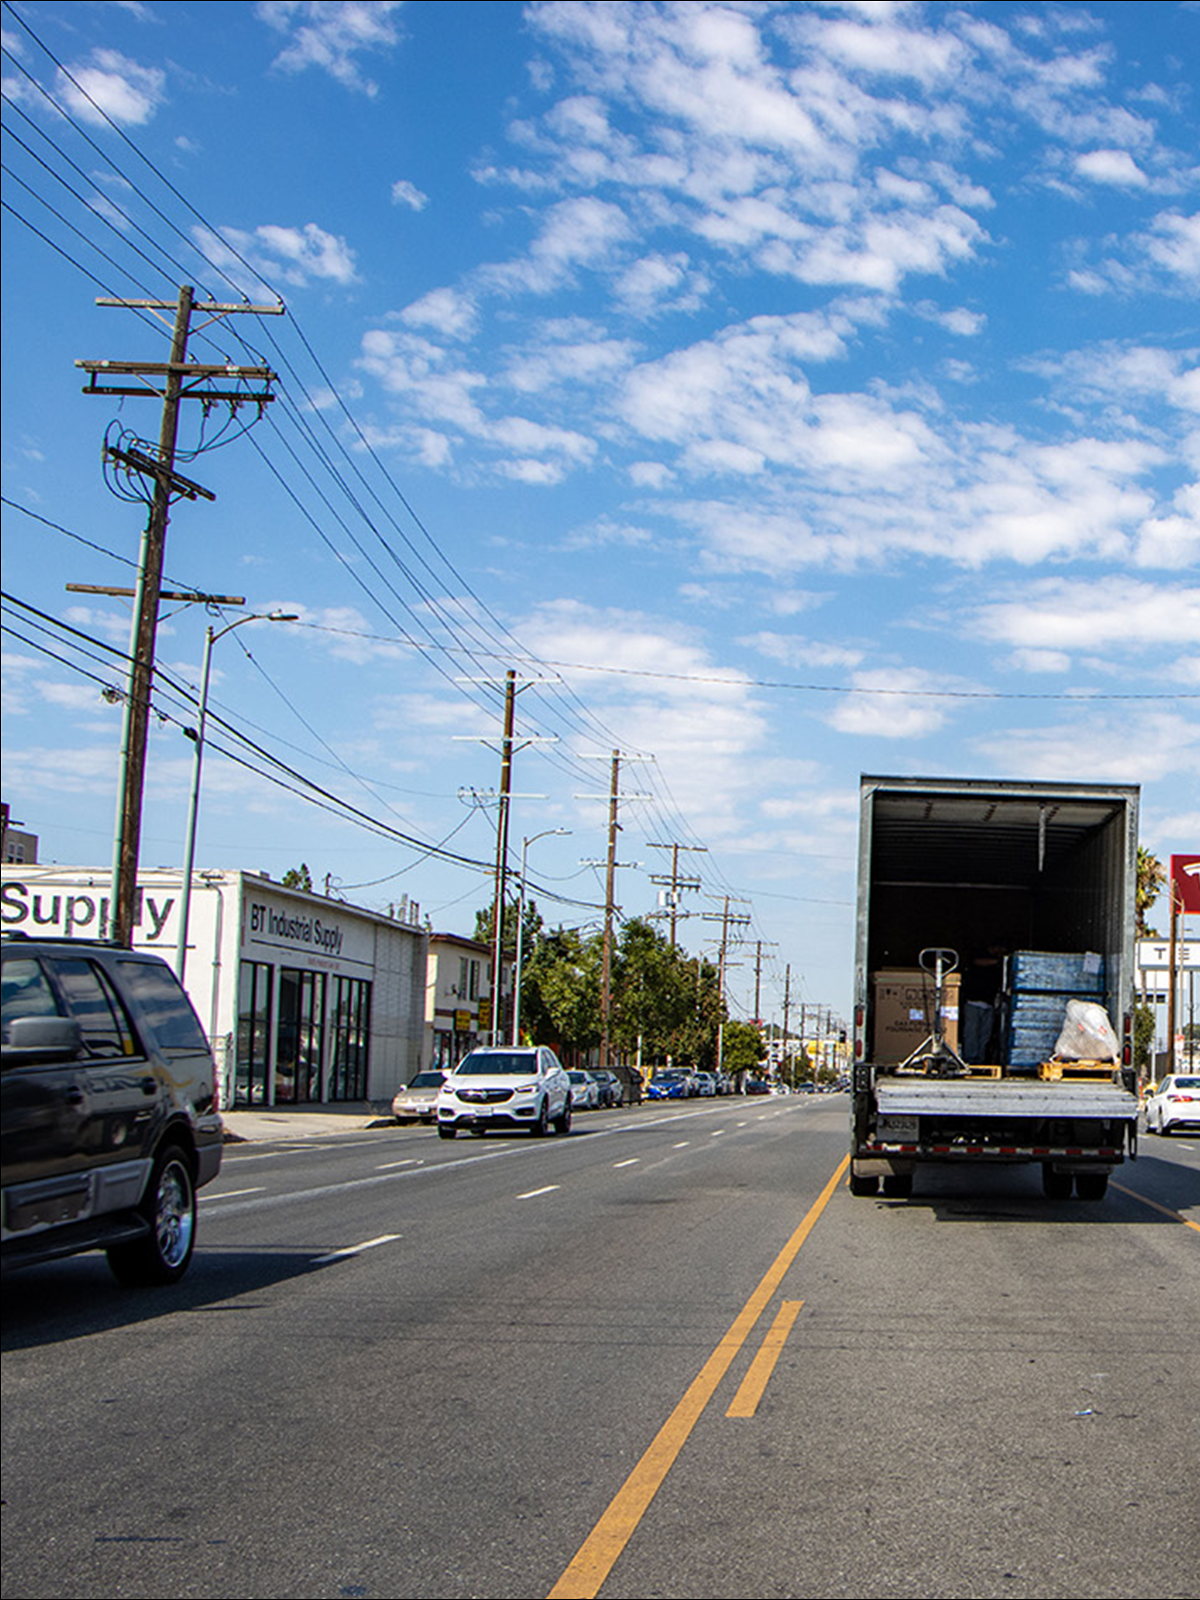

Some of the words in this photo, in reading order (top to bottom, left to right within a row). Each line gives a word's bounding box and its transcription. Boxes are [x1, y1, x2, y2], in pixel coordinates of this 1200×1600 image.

[251, 903, 266, 933] BT
[268, 907, 313, 943] Industrial
[314, 918, 343, 955] Supply
